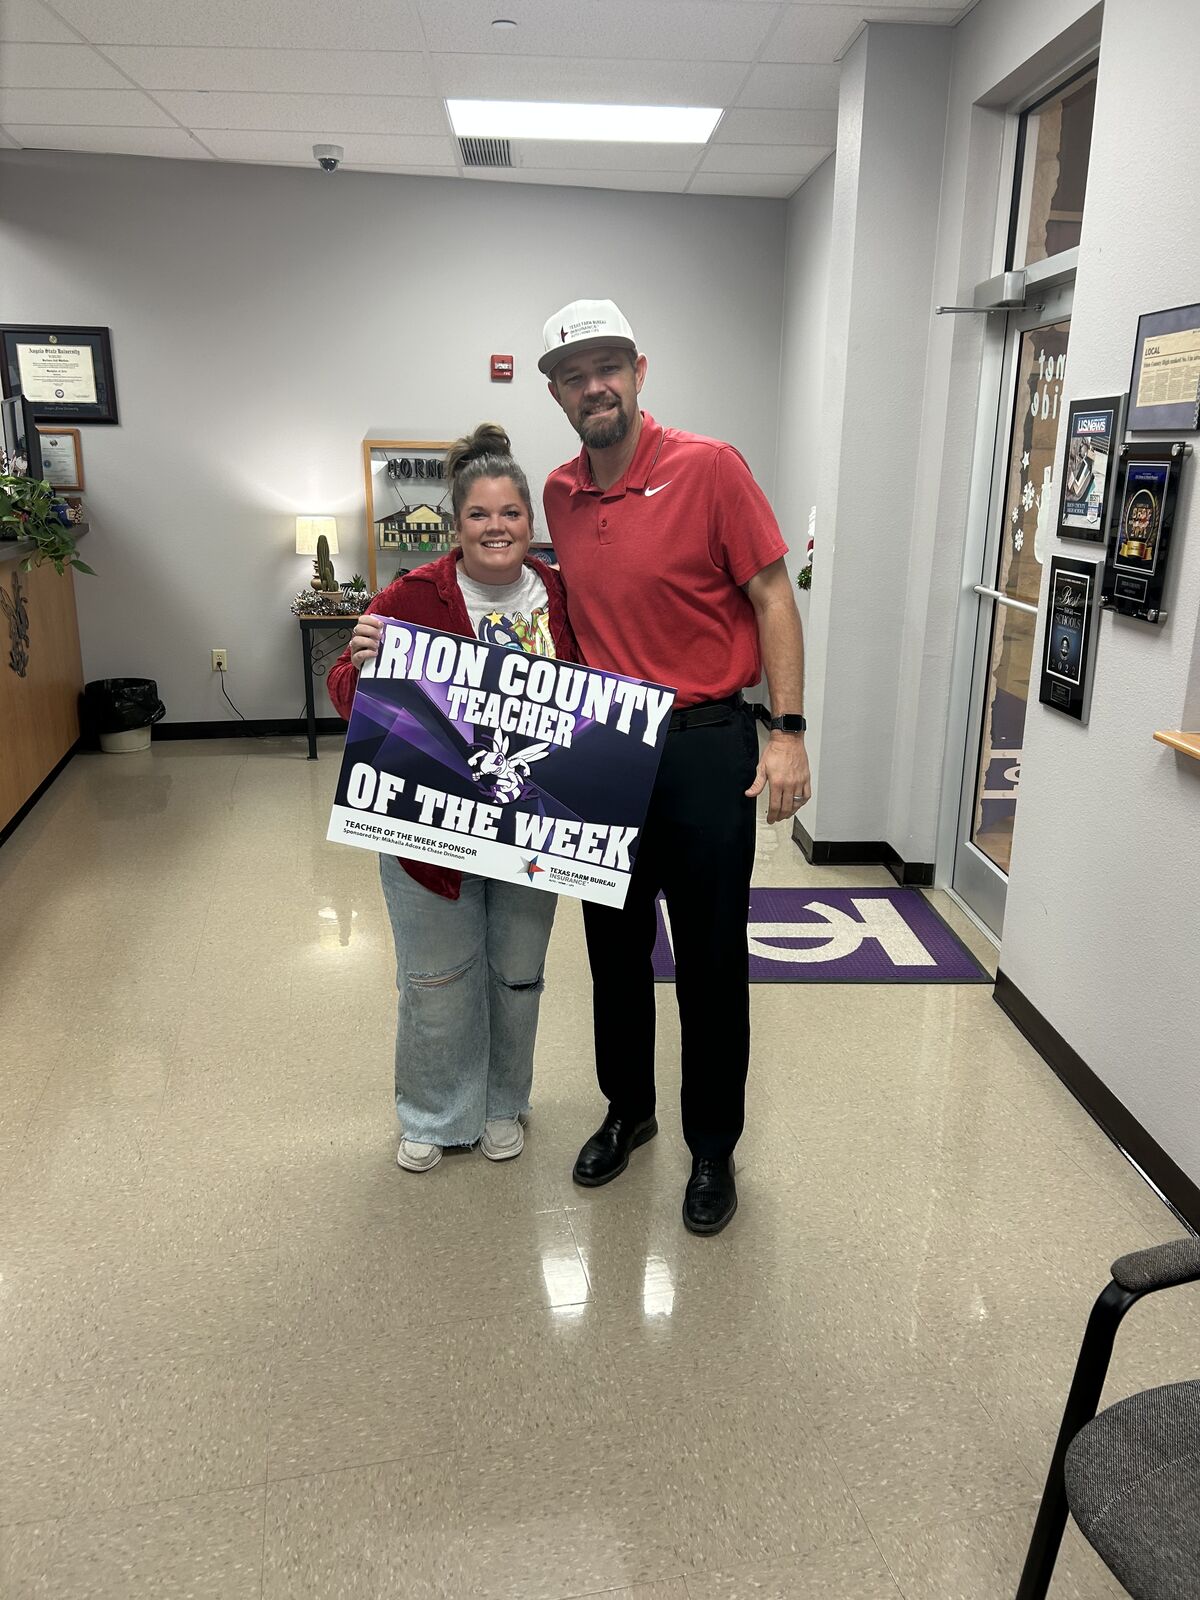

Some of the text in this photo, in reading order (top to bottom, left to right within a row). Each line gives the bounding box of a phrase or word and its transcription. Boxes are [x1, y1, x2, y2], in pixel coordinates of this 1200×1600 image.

[1145, 346, 1160, 356] LOCAL
[388, 458, 445, 479] HORN
[1055, 614, 1081, 630] SCHOOLS
[446, 685, 576, 748] TEACHER
[498, 653, 675, 748] COUNTY
[346, 762, 639, 872] OF THE WEEK
[343, 828, 372, 839] Sponsored
[372, 833, 381, 841] by:
[405, 841, 421, 850] Adcox
[427, 846, 443, 856] Chase
[443, 851, 465, 861] Drinnon
[345, 819, 478, 857] TEACHER OF THE WEEK SPONSOR
[550, 867, 616, 888] TEXAS FARM BUREAU
